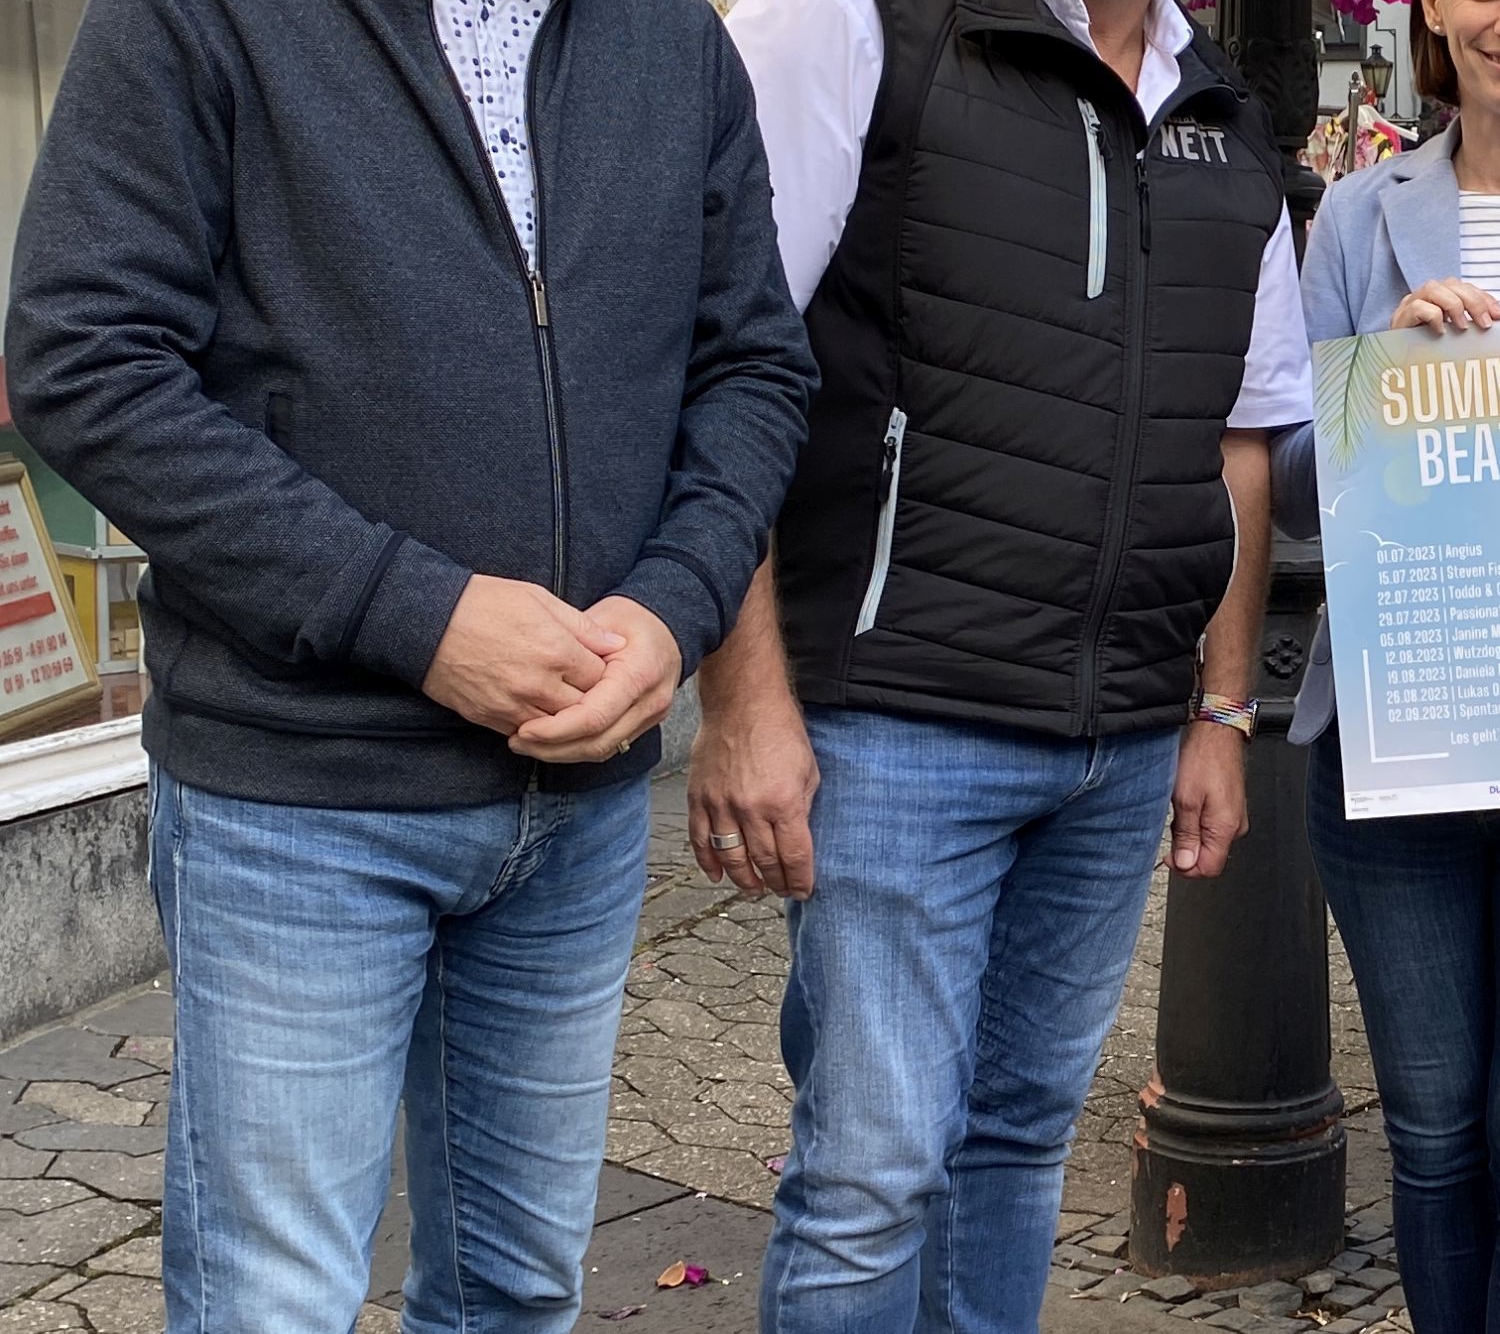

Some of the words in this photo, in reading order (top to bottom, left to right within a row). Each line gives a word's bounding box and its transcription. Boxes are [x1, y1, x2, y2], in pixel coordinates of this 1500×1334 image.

[1376, 546, 1435, 564] 01.07.2023
[1445, 545, 1482, 560] Angius
[1378, 567, 1437, 584] 15.07.2023
[1446, 566, 1485, 579] Steven
[1377, 587, 1438, 605] 22.07.2023
[1448, 585, 1481, 599] Toddo
[1484, 583, 1493, 596] &
[1378, 608, 1440, 626] 29.07.2023
[1379, 629, 1441, 647] 05.08.2023
[1451, 628, 1488, 641] Janine
[1385, 647, 1444, 664] 12.08.2023
[1387, 667, 1446, 684] 19.08.2023
[1455, 665, 1495, 679] Daniela
[1386, 686, 1448, 704] 26.08.2023
[1457, 685, 1489, 698] Lukas
[1387, 705, 1449, 722] 02.09.2023
[1450, 731, 1469, 744] Los
